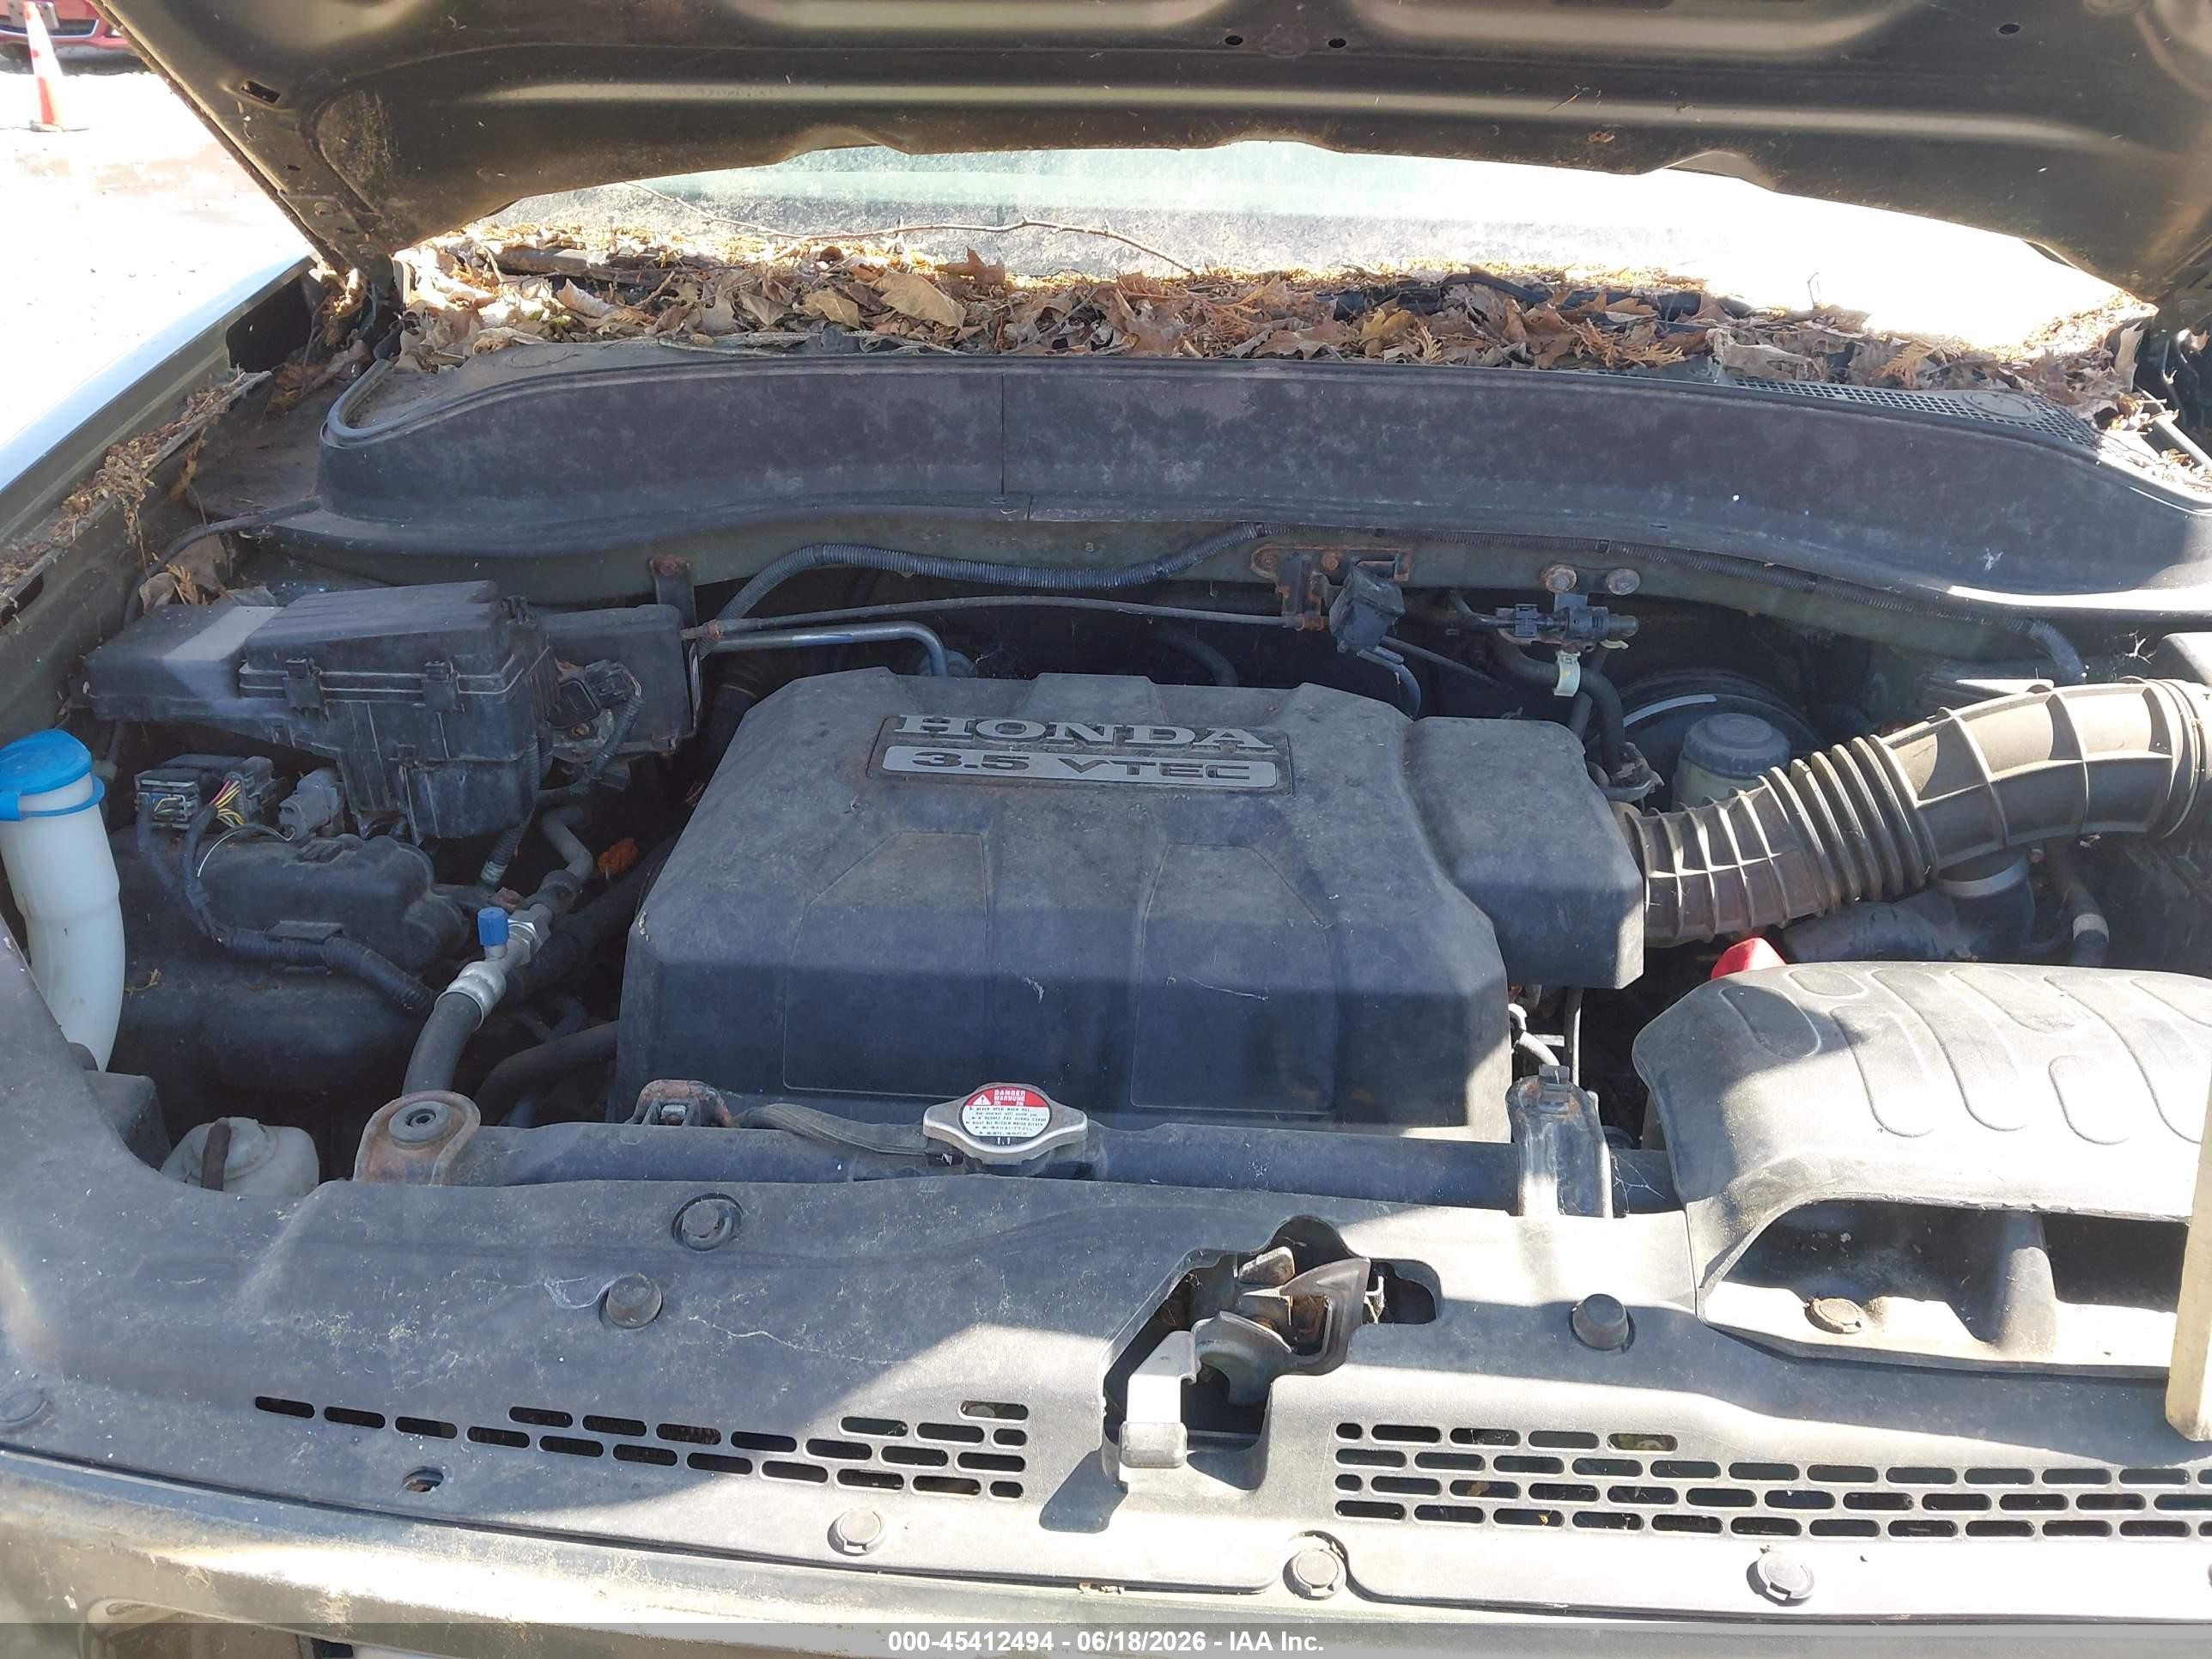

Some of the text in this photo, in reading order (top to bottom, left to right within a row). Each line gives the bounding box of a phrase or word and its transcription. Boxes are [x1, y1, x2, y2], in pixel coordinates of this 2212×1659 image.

[893, 714, 1275, 750] HONDA
[912, 751, 1250, 781] 3.5 VTEC
[997, 1137, 1011, 1146] 1.1
